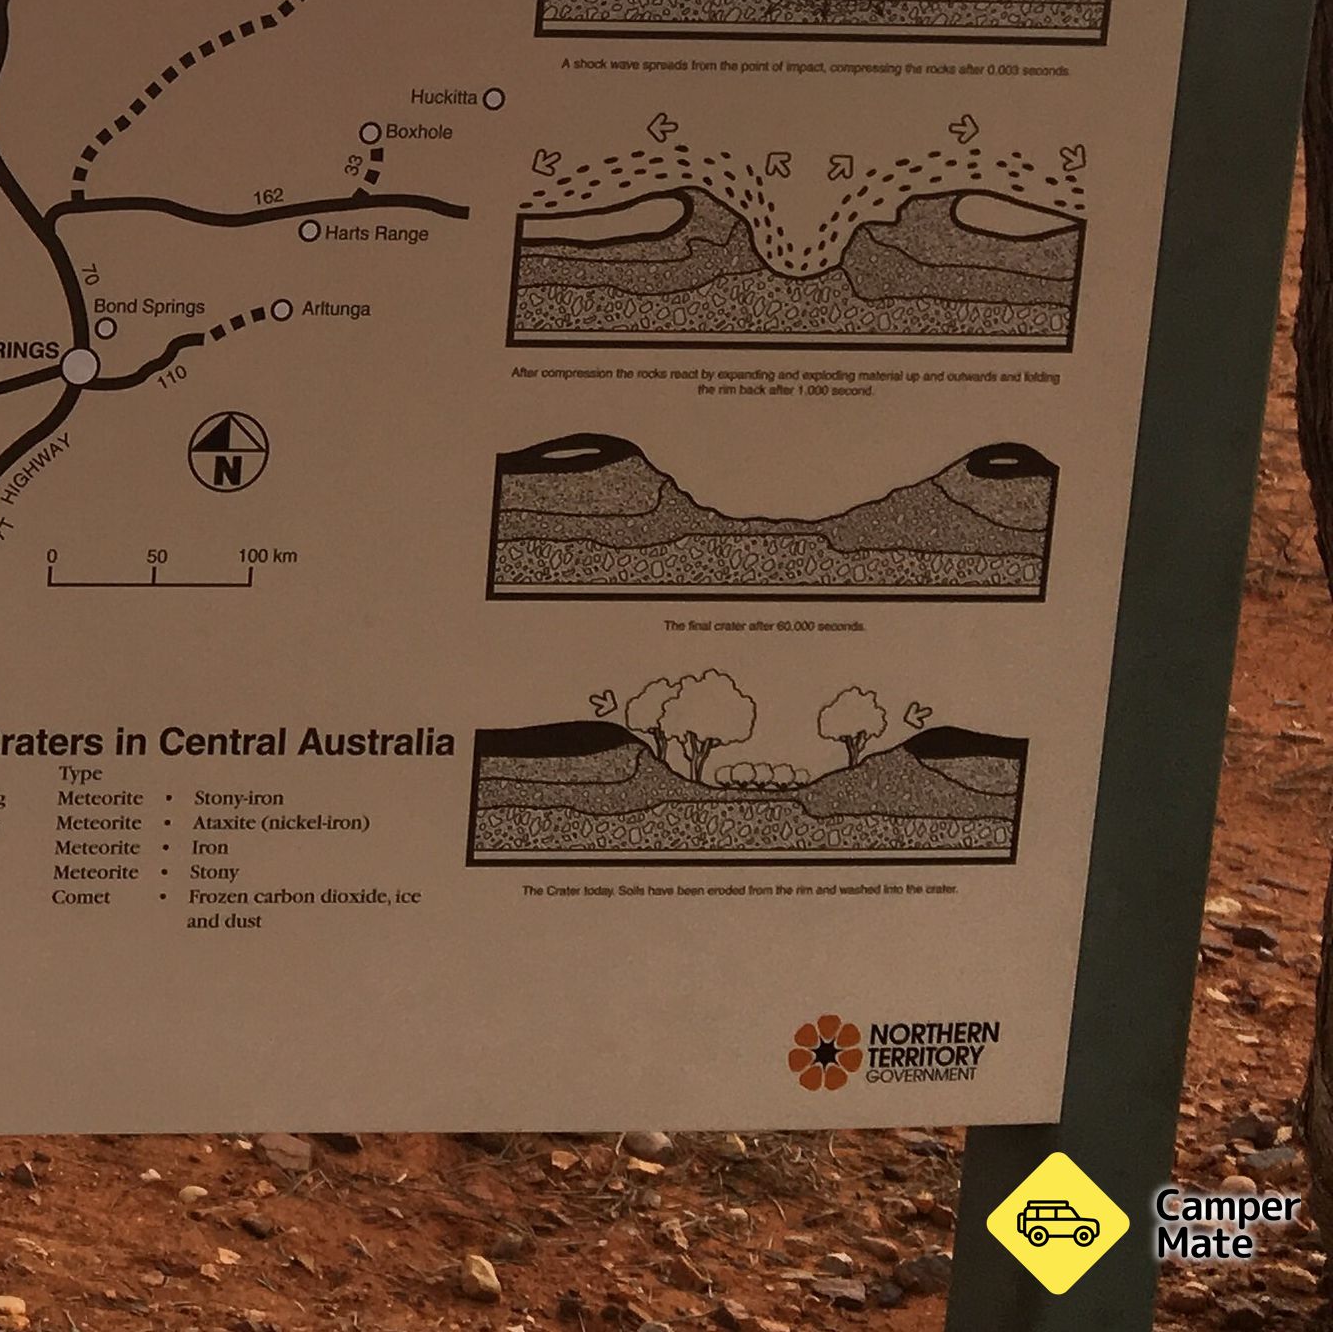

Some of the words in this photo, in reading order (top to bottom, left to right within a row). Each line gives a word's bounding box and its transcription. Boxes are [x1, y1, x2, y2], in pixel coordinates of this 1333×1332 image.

[410, 88, 478, 105] Huckitta
[385, 123, 453, 140] Boxhole
[344, 154, 363, 176] 33
[254, 187, 284, 205] 162
[325, 225, 370, 241] Harts
[374, 225, 429, 245] Range
[81, 262, 100, 286] 70
[93, 297, 138, 315] Bond
[142, 297, 205, 318] Springs
[301, 300, 371, 321] Arltunga
[157, 365, 187, 389] 110
[0, 432, 71, 505] HIGHWAY
[213, 455, 243, 486] N
[46, 548, 58, 568] 0
[146, 548, 168, 564] 50
[239, 548, 269, 564] 100
[272, 548, 298, 563] km
[663, 619, 686, 632] The
[687, 619, 713, 632] final
[748, 620, 775, 632] after
[115, 726, 147, 756] in
[159, 726, 287, 756] Central
[297, 727, 455, 756] Australia
[58, 765, 103, 785] Type
[58, 790, 144, 806] Meteorite
[194, 790, 284, 810] Stony-iron
[56, 815, 142, 831] Meteorite
[193, 815, 257, 830] Ataxite
[261, 814, 370, 832] (nickel-iron)
[869, 1021, 1000, 1046] NORTHERN
[867, 1043, 985, 1068] TERRITORY
[865, 1067, 977, 1083] GOVERNMENT
